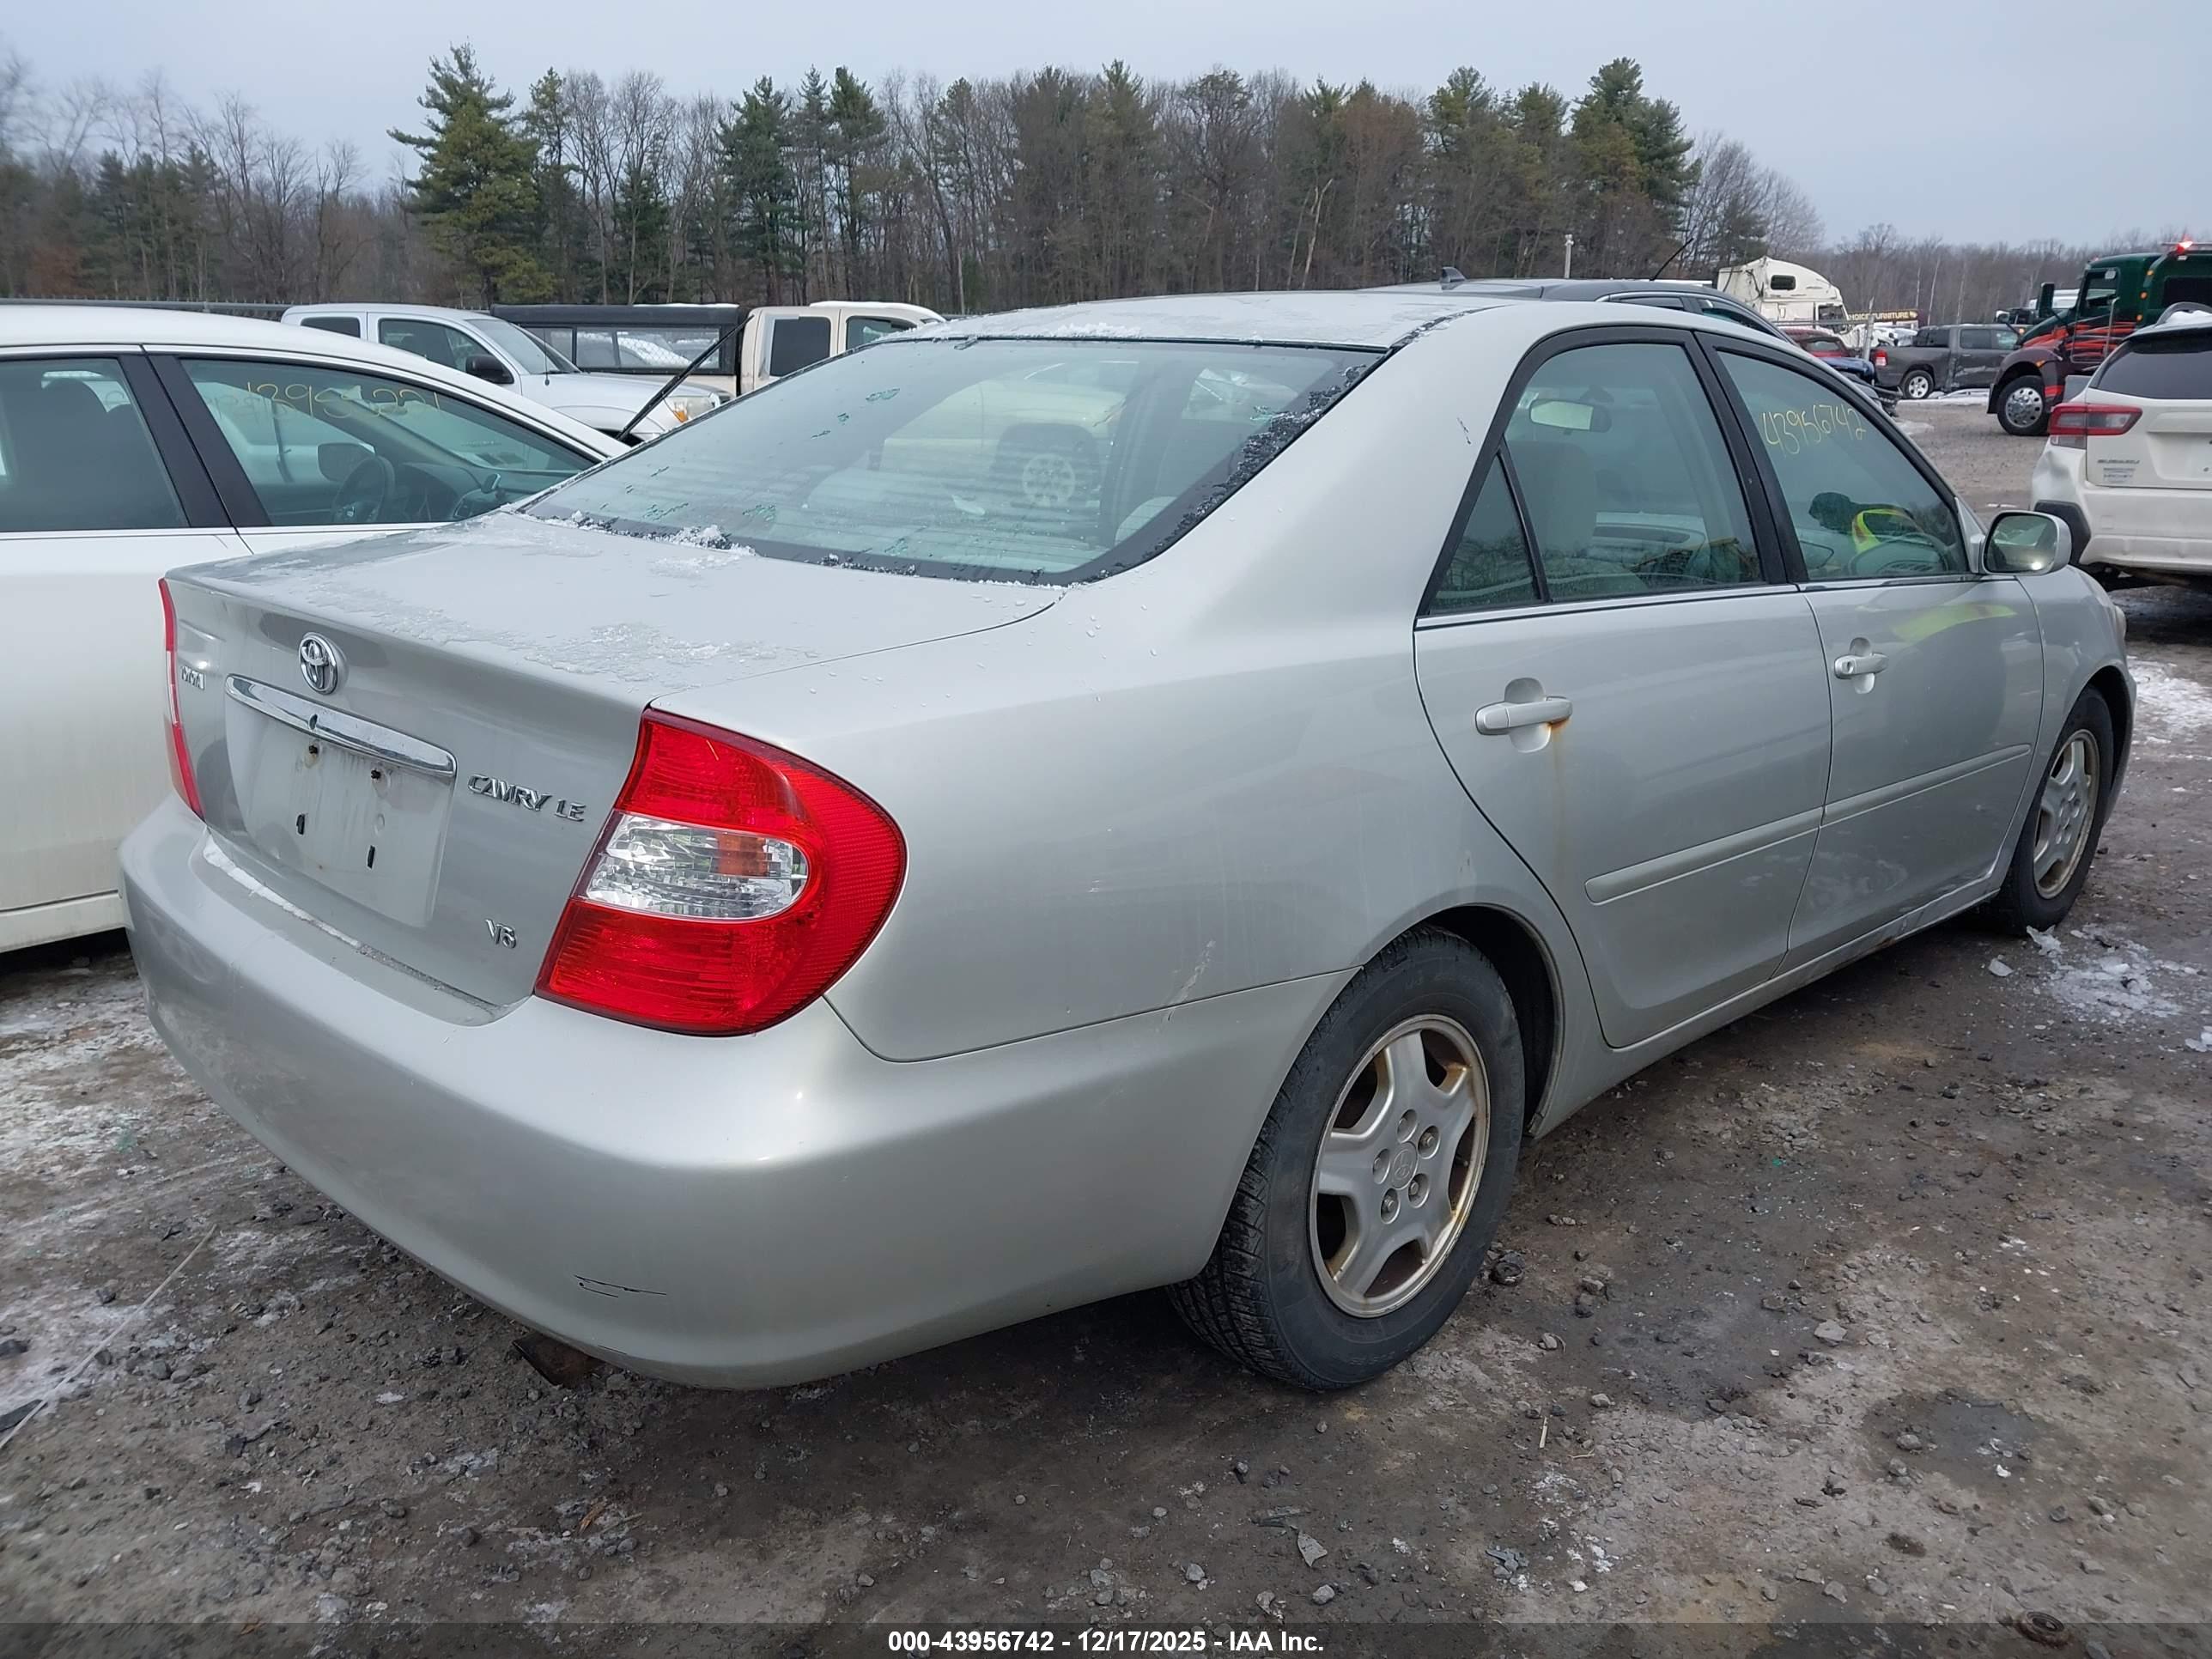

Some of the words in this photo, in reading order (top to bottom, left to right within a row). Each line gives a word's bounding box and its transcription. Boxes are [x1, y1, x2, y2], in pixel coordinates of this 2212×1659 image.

[1762, 403, 1867, 459] 43956742
[468, 773, 552, 811] CAMRY
[554, 798, 586, 822] LE
[484, 918, 517, 949] V6
